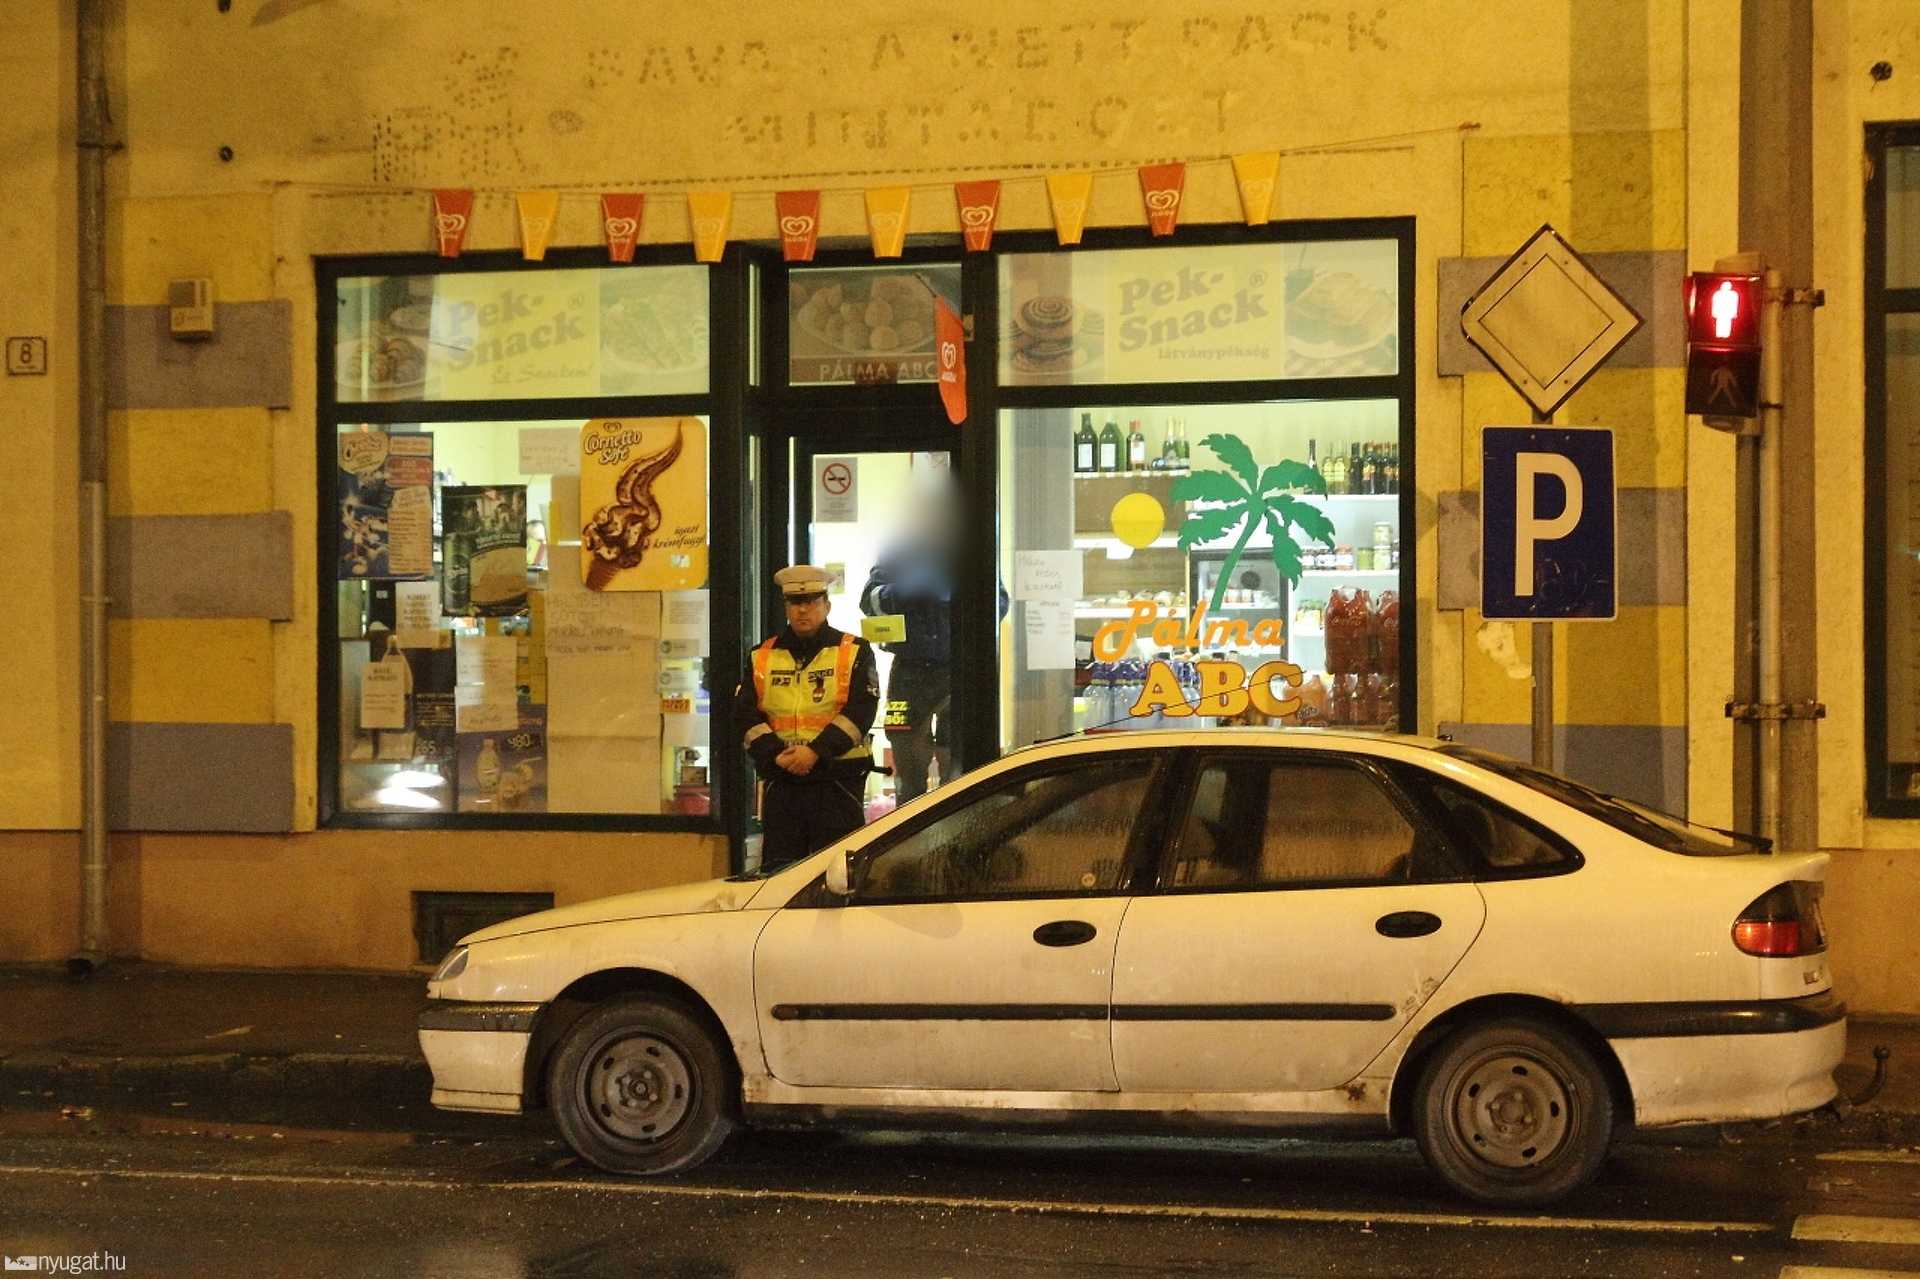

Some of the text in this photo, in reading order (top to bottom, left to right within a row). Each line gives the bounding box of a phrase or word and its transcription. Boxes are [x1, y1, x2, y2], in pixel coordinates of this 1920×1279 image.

[1119, 266, 1224, 316] Pek-
[448, 311, 585, 372] Snack
[1119, 288, 1270, 352] Snack
[20, 343, 32, 364] 8
[820, 360, 890, 381] PÁLMA
[897, 361, 938, 380] ABC
[584, 431, 642, 455] Cornetto
[599, 446, 630, 465] Soft
[1515, 452, 1583, 597] P
[1093, 600, 1286, 663] Pálma
[1129, 660, 1304, 717] ABC
